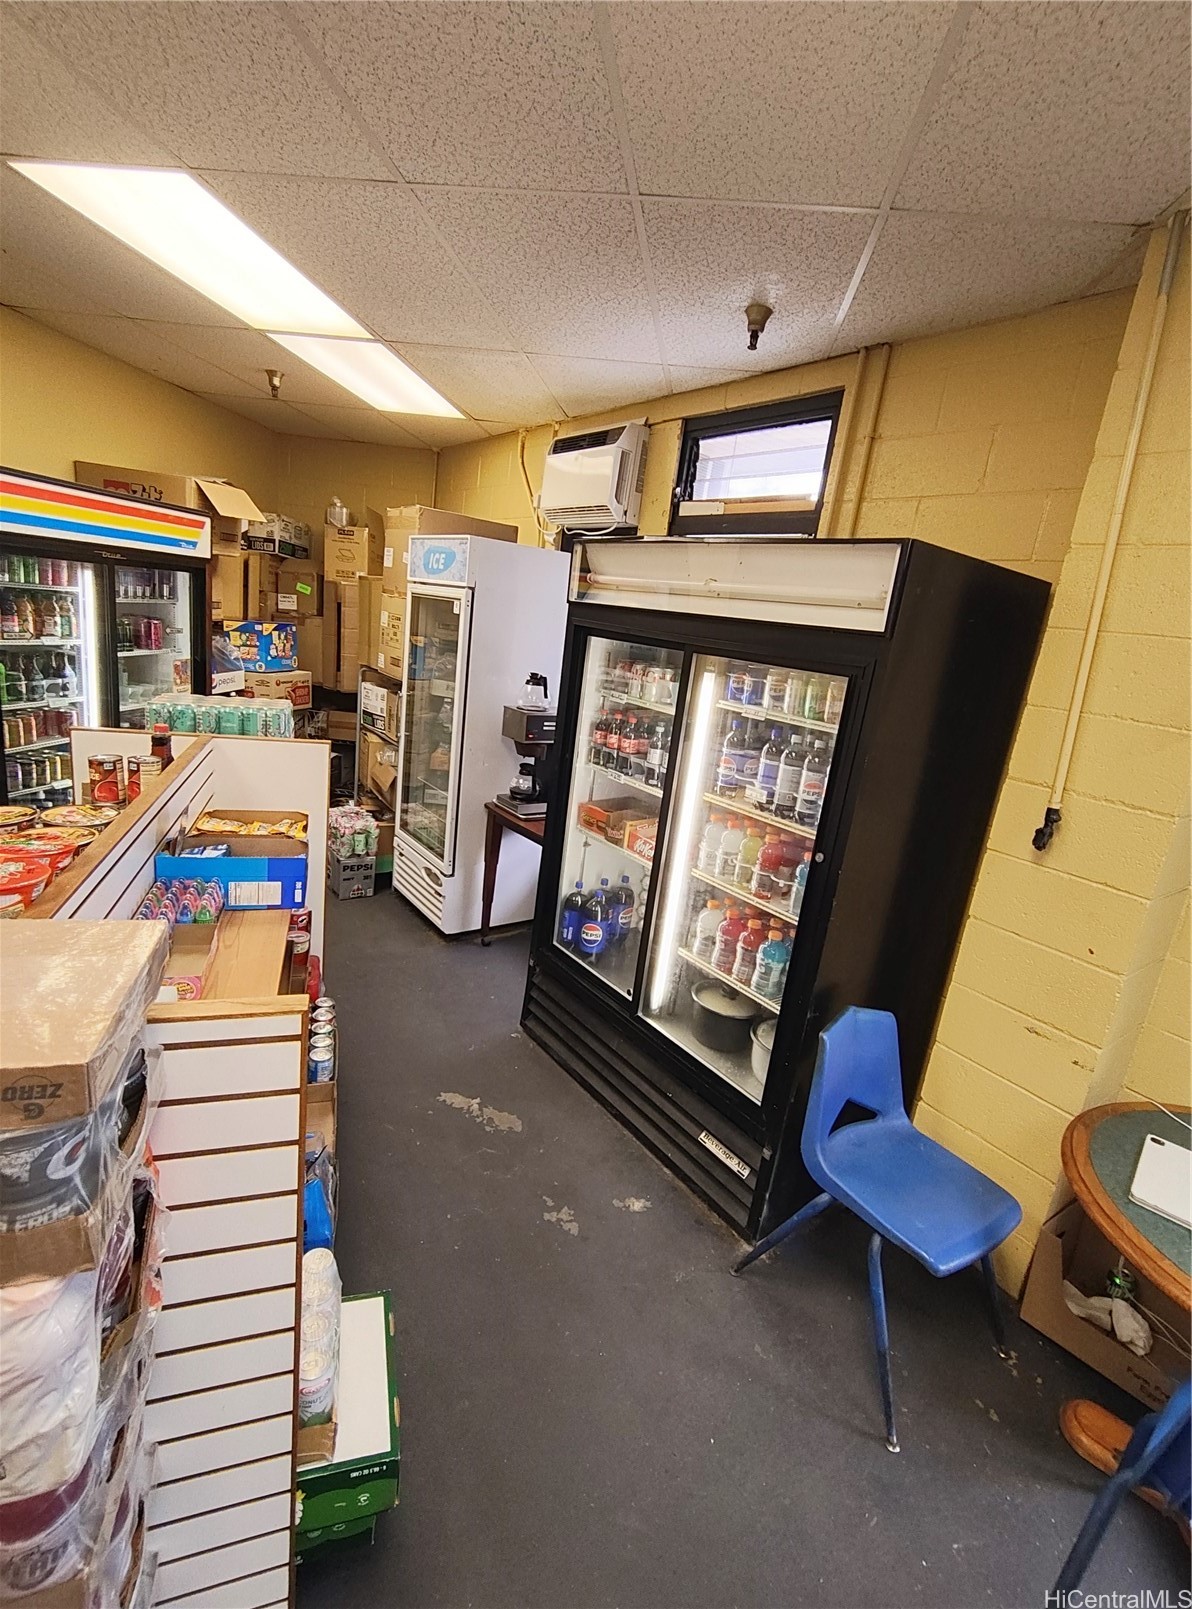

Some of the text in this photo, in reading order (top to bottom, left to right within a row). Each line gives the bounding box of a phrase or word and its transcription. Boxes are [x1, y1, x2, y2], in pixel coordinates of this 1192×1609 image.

[428, 552, 446, 570] ICE
[218, 676, 236, 686] pepsi
[802, 789, 823, 798] PEPS
[342, 863, 373, 872] PEPSI
[2, 1083, 65, 1102] ZERO
